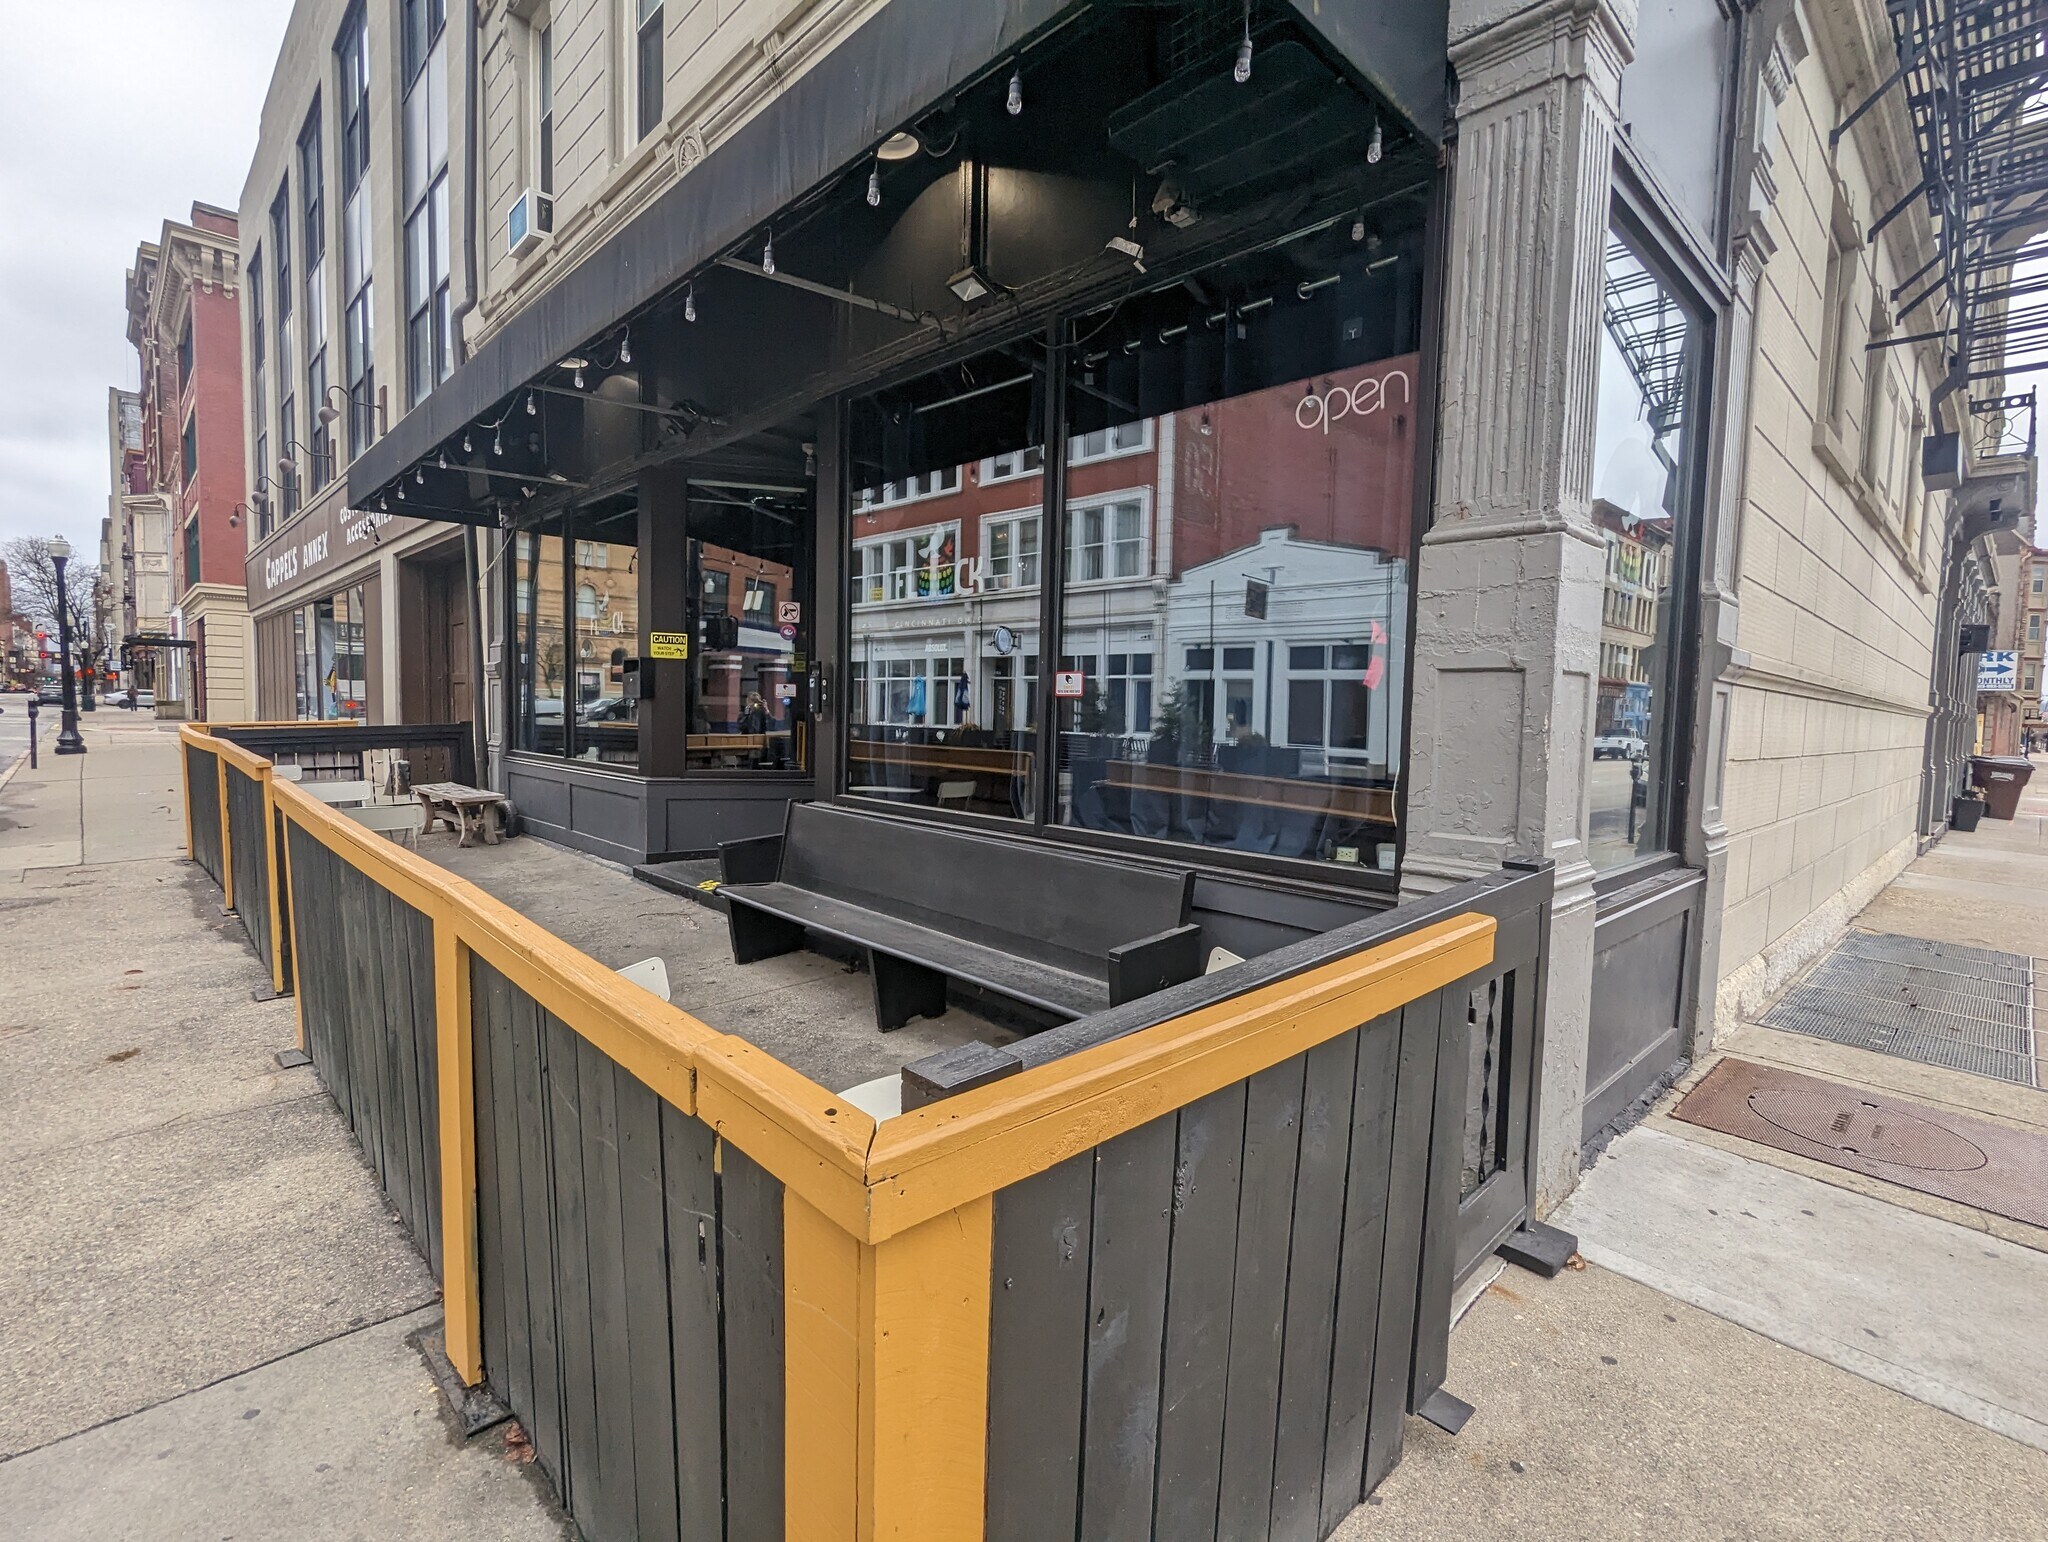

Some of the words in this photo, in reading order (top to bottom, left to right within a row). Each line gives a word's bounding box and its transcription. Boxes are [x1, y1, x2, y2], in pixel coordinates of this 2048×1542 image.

[1295, 370, 1410, 435] open
[303, 531, 329, 570] ANNEX
[653, 635, 686, 644] CAUTION
